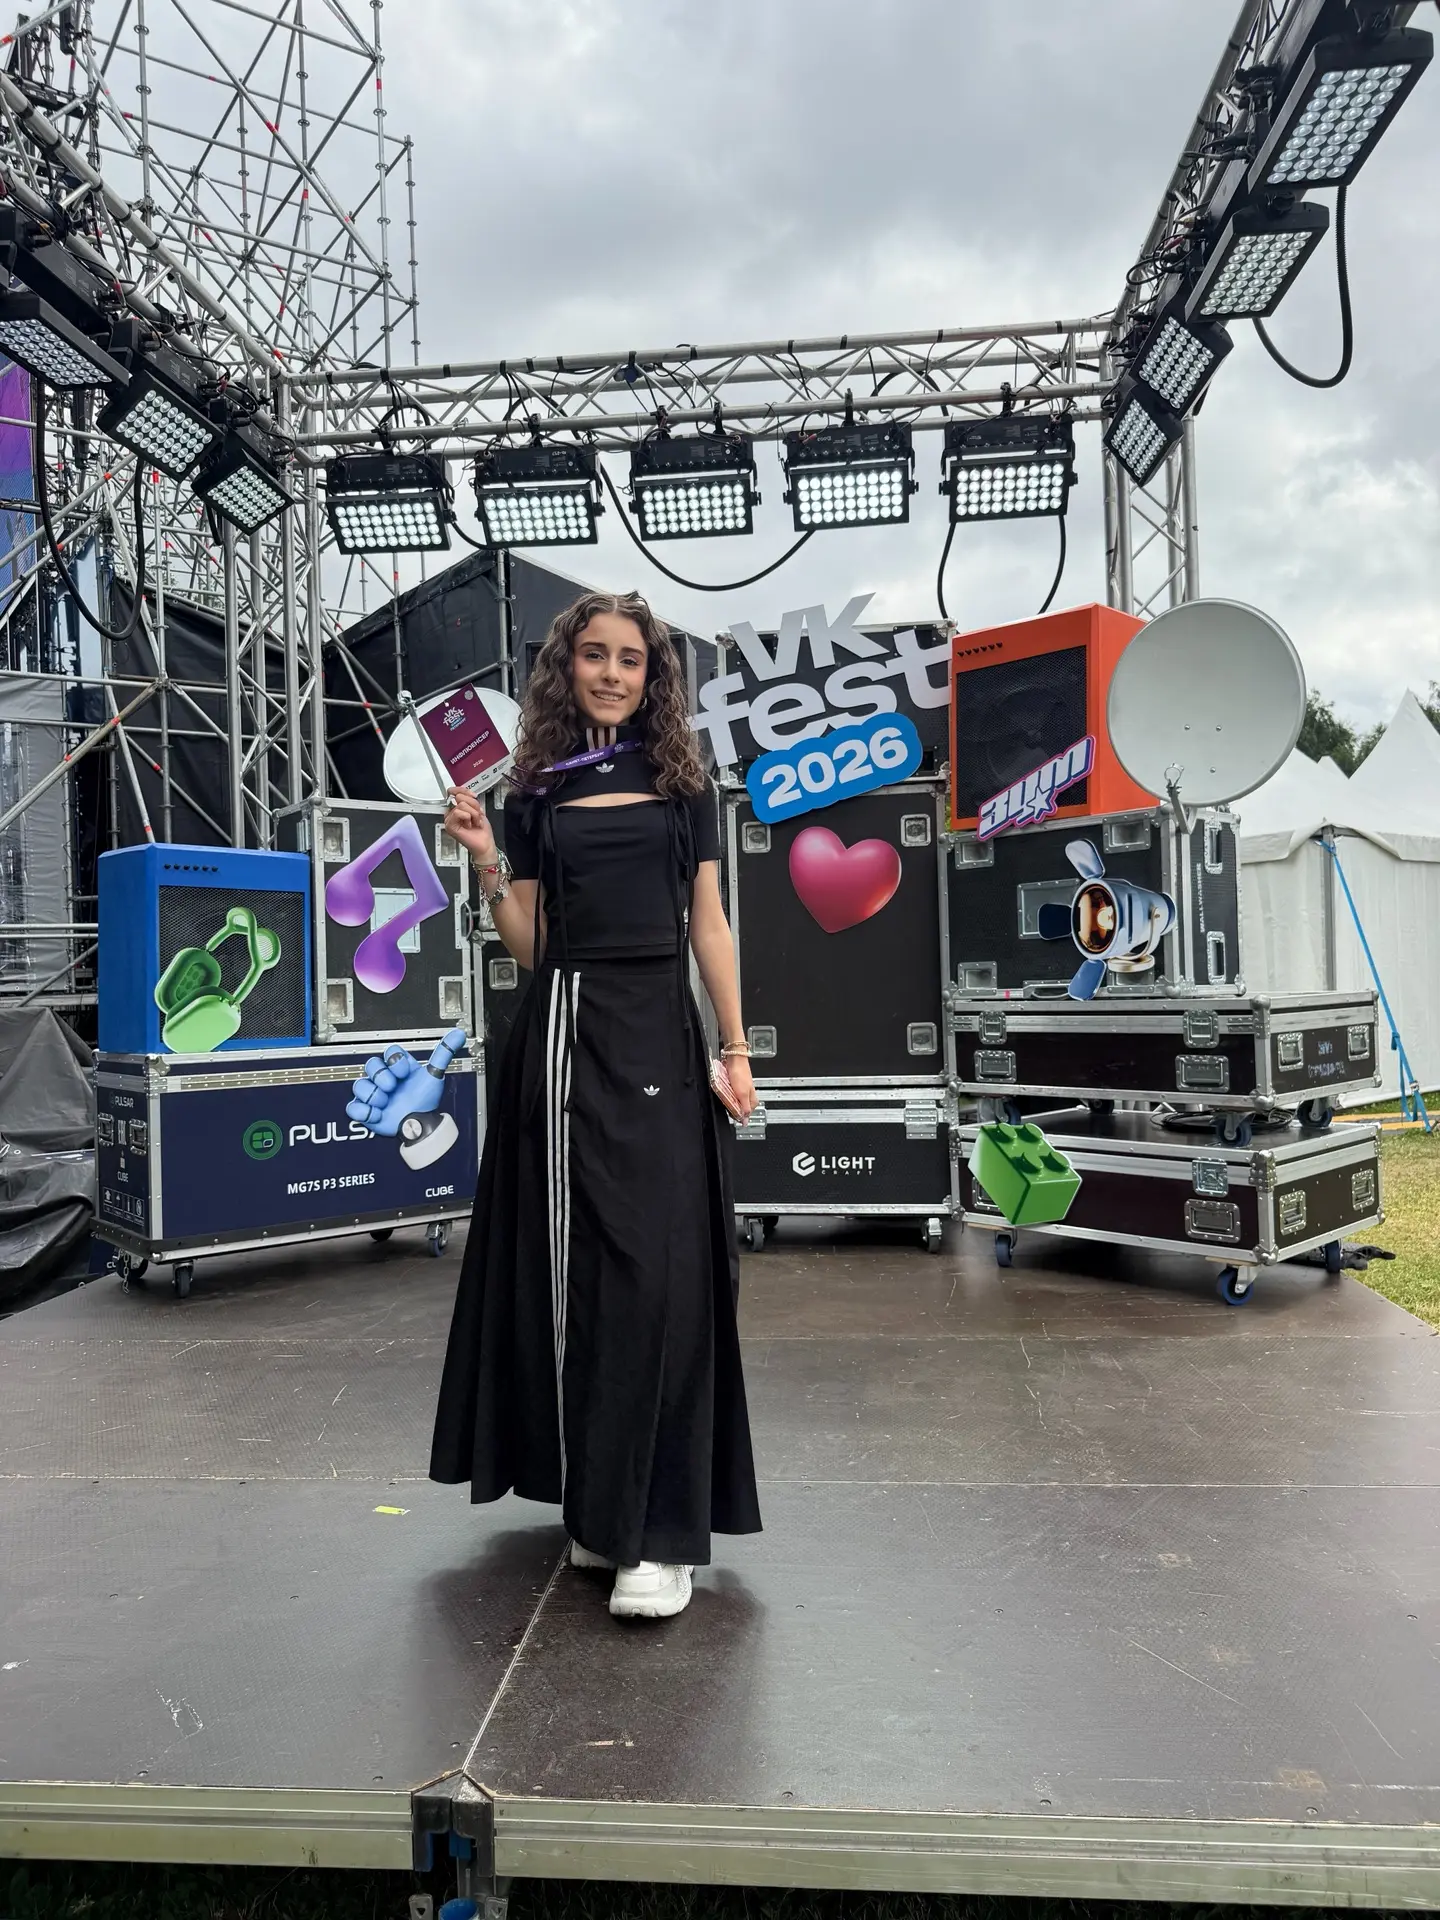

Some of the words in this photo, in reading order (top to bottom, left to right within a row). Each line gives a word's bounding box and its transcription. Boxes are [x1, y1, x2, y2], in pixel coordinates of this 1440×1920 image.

[728, 592, 890, 682] VK
[685, 629, 952, 768] fest
[443, 708, 465, 726] fest
[444, 706, 457, 718] VK
[449, 730, 490, 765] ИНФЛЮЕНСЕР
[761, 727, 909, 809] 2026
[466, 780, 479, 790] ZON
[1196, 863, 1205, 933] WALLWASHER
[289, 1120, 376, 1147] PULS
[821, 1156, 876, 1169] LIGHT
[287, 1180, 321, 1195] MG7S
[322, 1177, 337, 1190] P3
[338, 1173, 375, 1188] SERIES
[425, 1185, 454, 1198] CUBE
